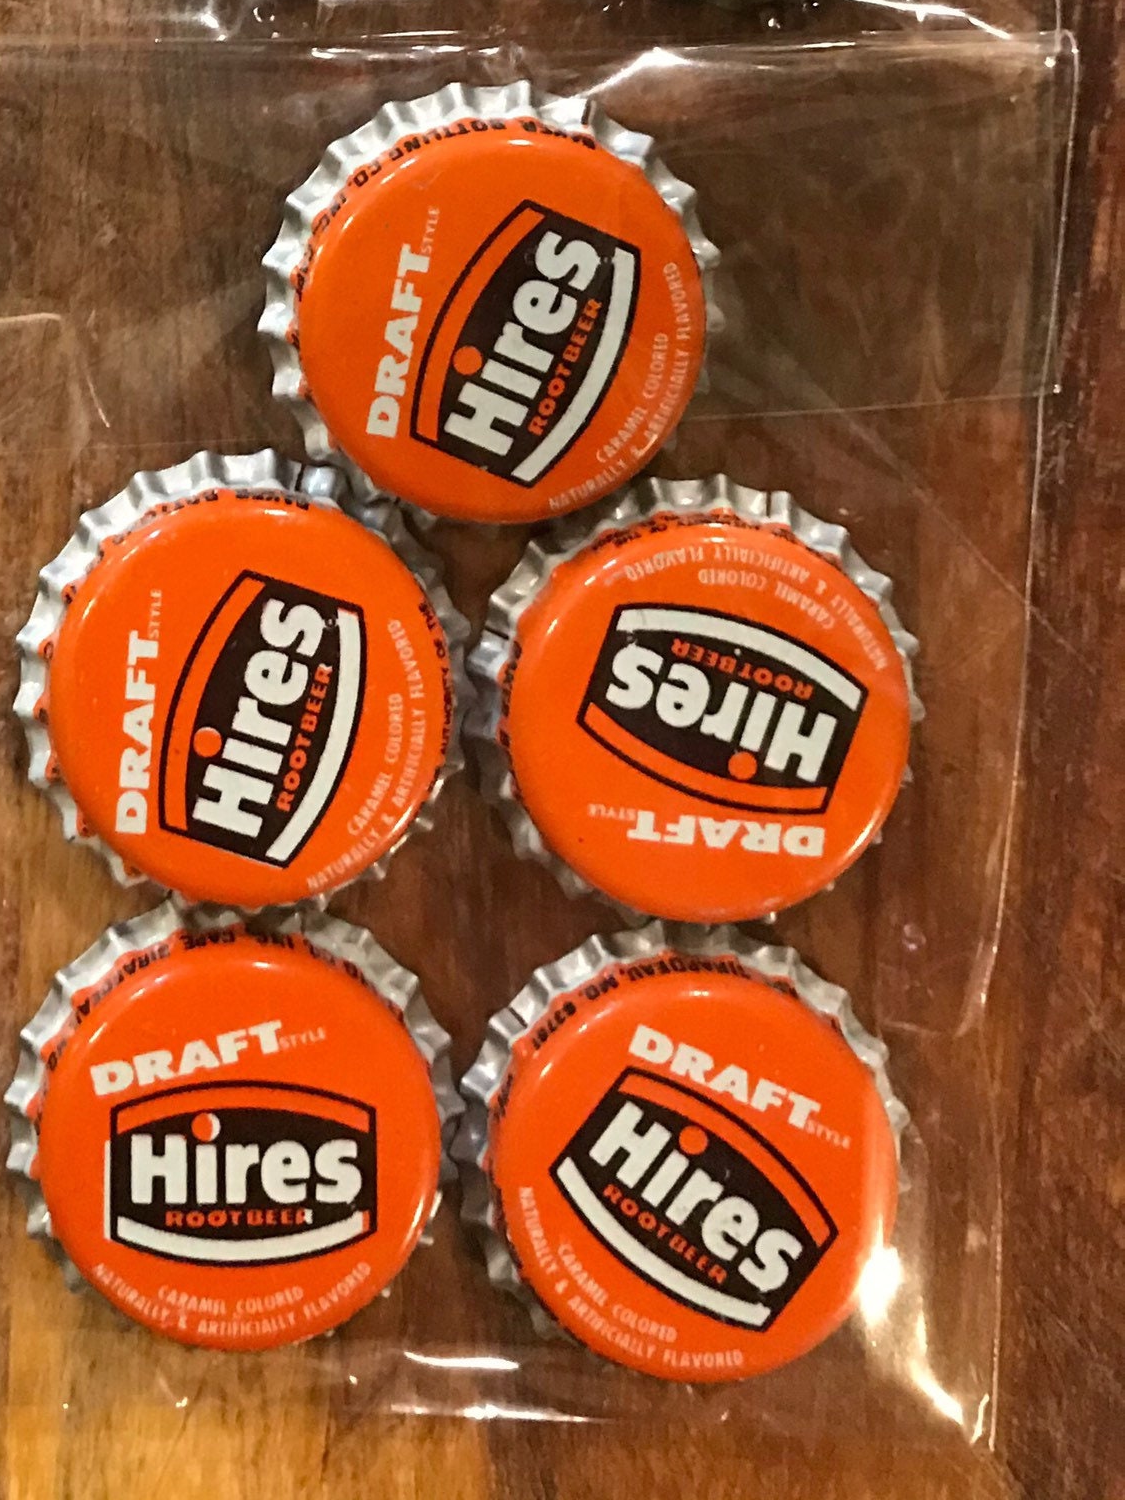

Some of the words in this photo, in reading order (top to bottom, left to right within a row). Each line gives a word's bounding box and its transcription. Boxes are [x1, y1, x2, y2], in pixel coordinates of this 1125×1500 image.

[367, 243, 432, 440] DRAFT
[443, 230, 602, 457] Hires
[642, 334, 666, 399] COLORED
[699, 570, 766, 588] COLORED
[773, 582, 836, 629] CARAMEL
[386, 618, 422, 696] FLAVORED
[115, 630, 160, 835] DRAFT
[192, 597, 327, 840] Hires
[345, 770, 391, 836] CARAMEL
[383, 695, 401, 763] COLORED
[605, 643, 838, 783] Hires
[626, 810, 825, 858] DRAFT
[90, 1020, 282, 1097] DRAFT
[628, 1024, 821, 1130] DRAFT
[130, 1113, 363, 1205] Hires
[588, 1100, 803, 1293] Hires
[520, 1188, 557, 1275] NATURALLY
[663, 1348, 743, 1366] FLAVORED
[556, 1243, 609, 1305] CARAMEL
[612, 1303, 675, 1341] COLORED
